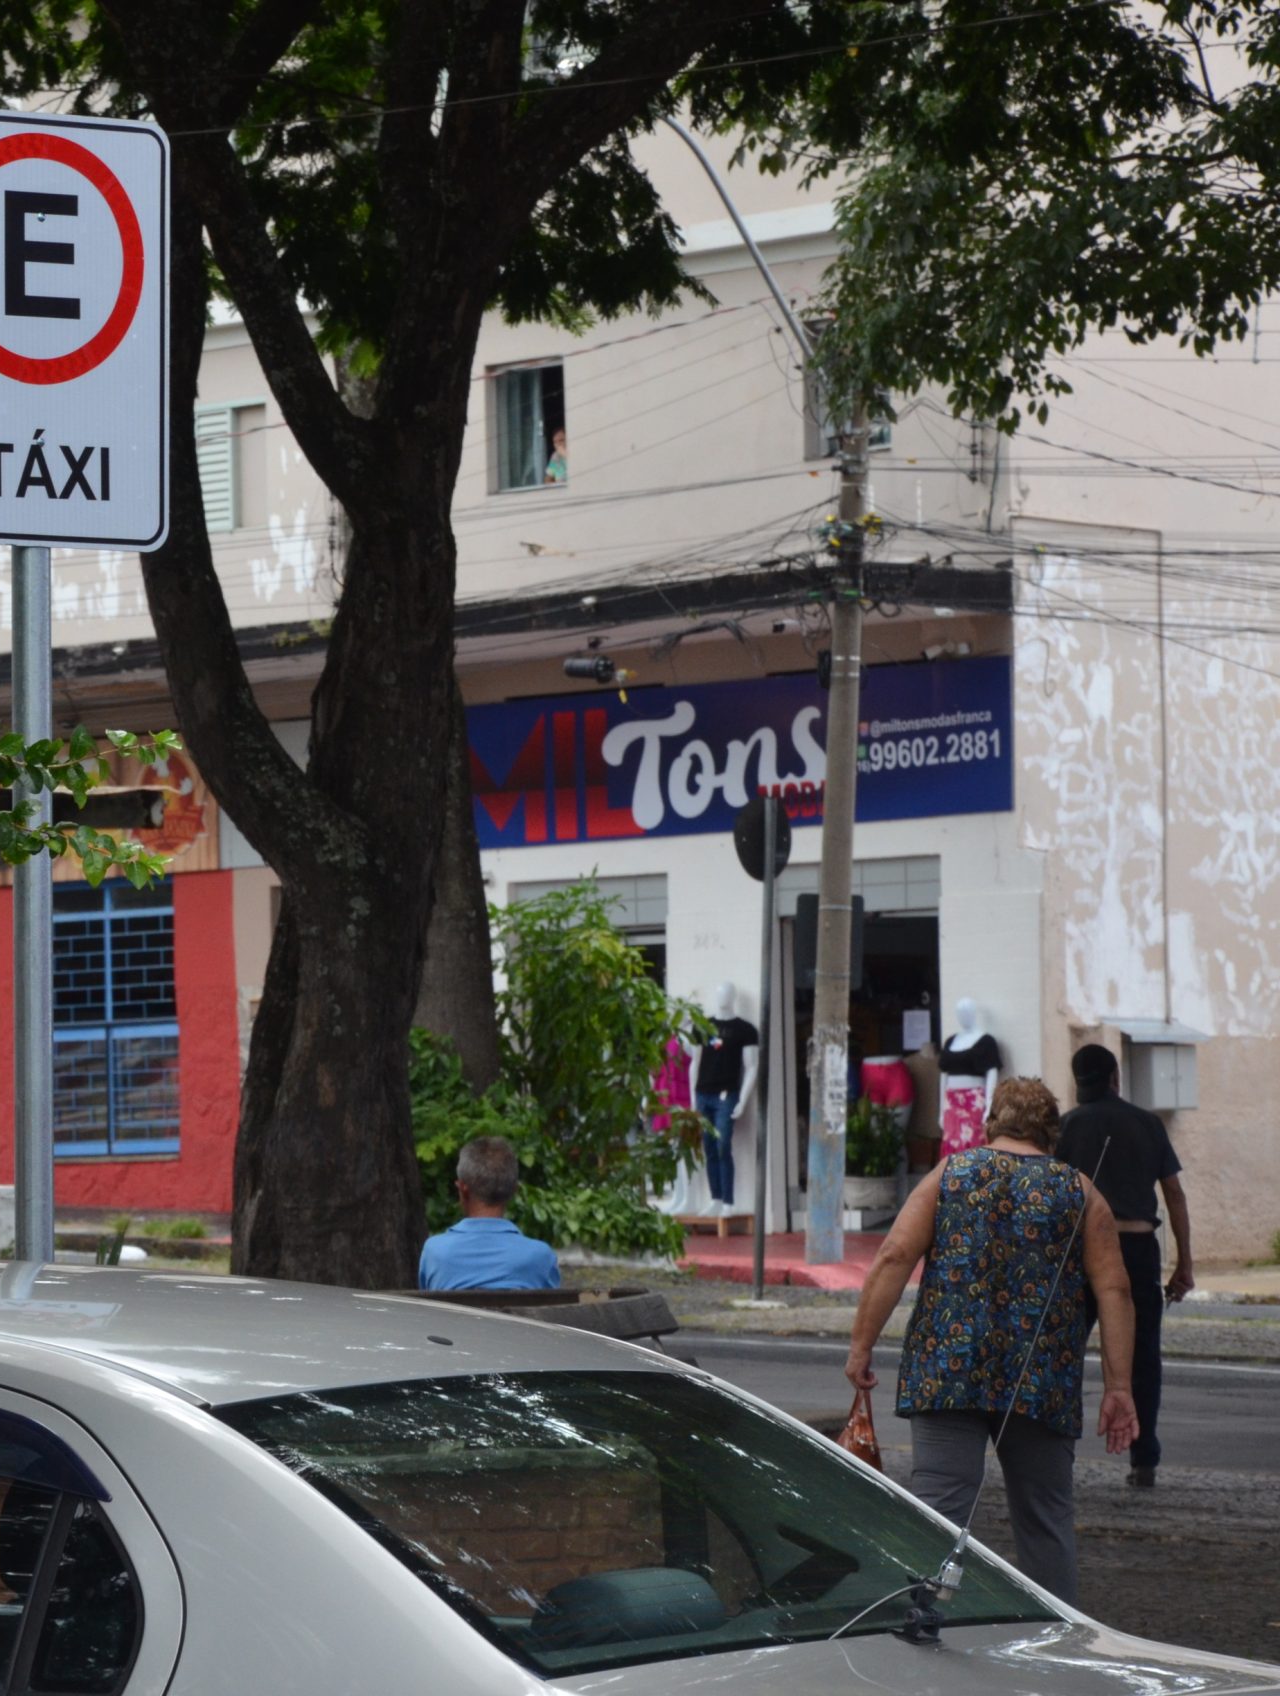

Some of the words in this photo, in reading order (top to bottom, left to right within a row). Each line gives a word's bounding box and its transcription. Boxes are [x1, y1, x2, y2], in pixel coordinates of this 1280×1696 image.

[4, 189, 81, 320] E
[870, 711, 992, 738] @miltonsmodasfranca
[870, 728, 1001, 772] 99602.2881
